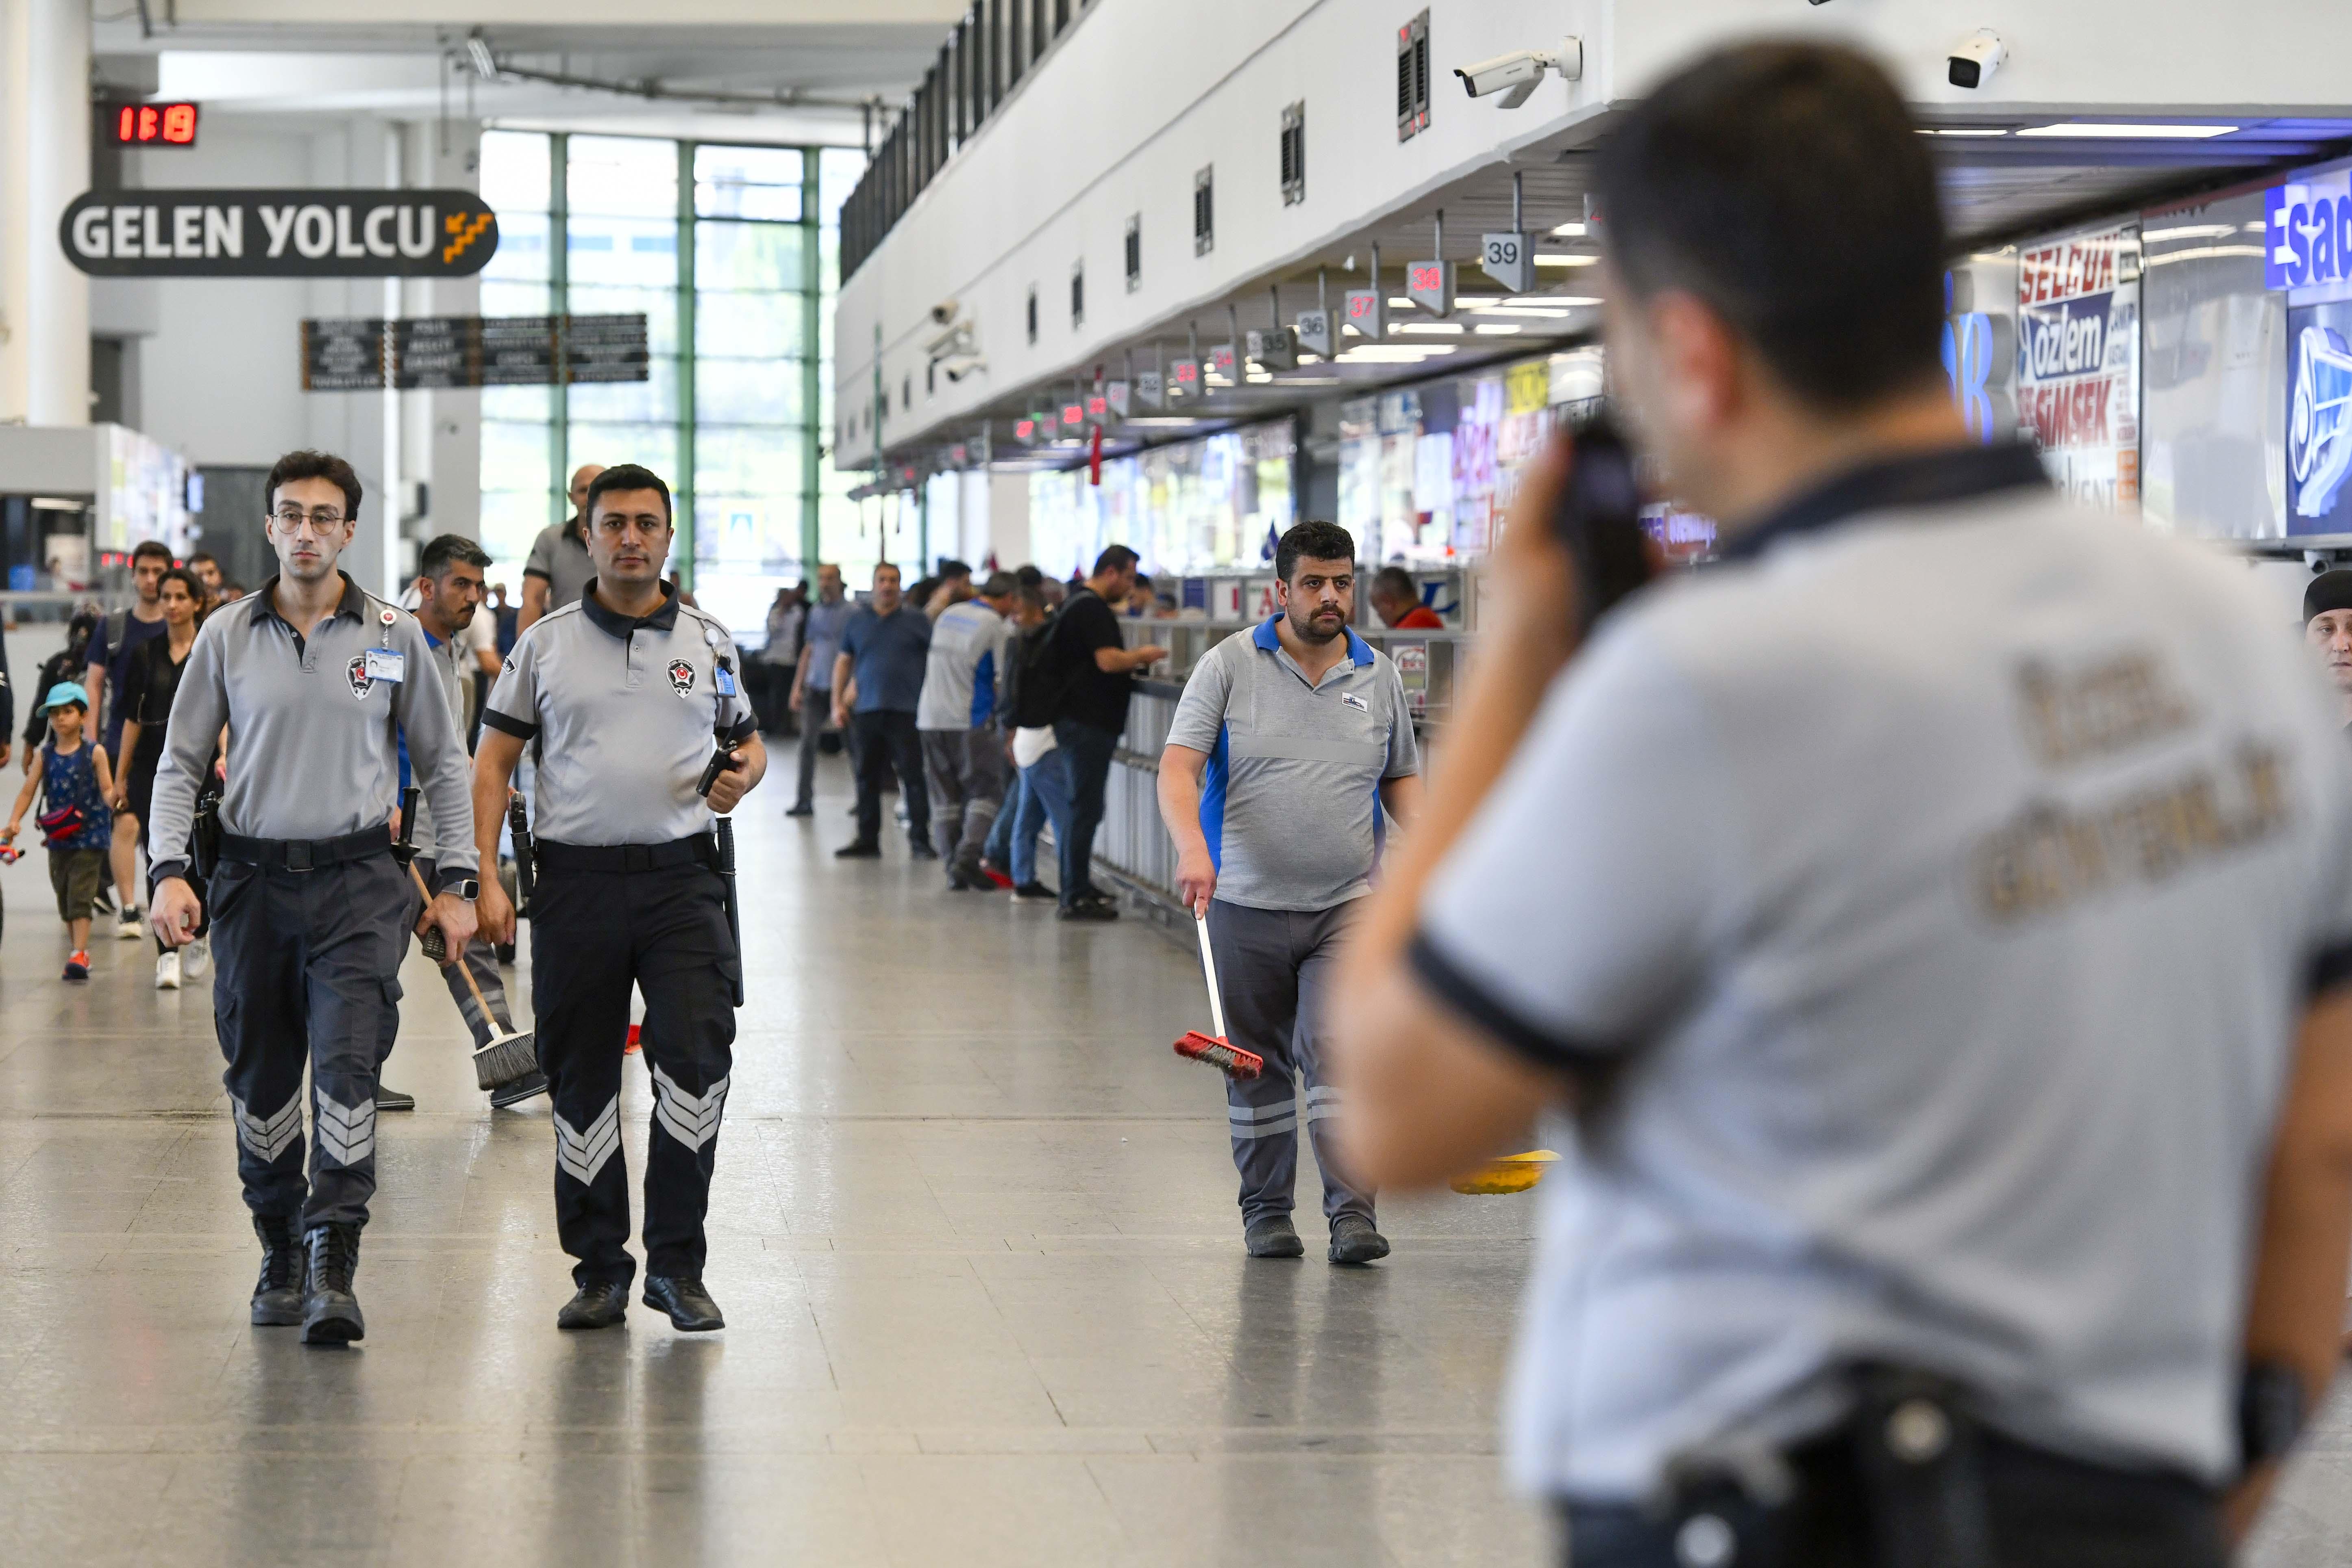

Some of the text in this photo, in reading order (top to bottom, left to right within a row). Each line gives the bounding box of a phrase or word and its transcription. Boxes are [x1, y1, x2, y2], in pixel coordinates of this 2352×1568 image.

[72, 204, 435, 259] GELEN YOLCU
[1489, 241, 1517, 264] 39
[1412, 267, 1440, 291] 38
[1350, 296, 1375, 318] 37
[1301, 317, 1323, 337] 36
[1177, 364, 1197, 382] 33
